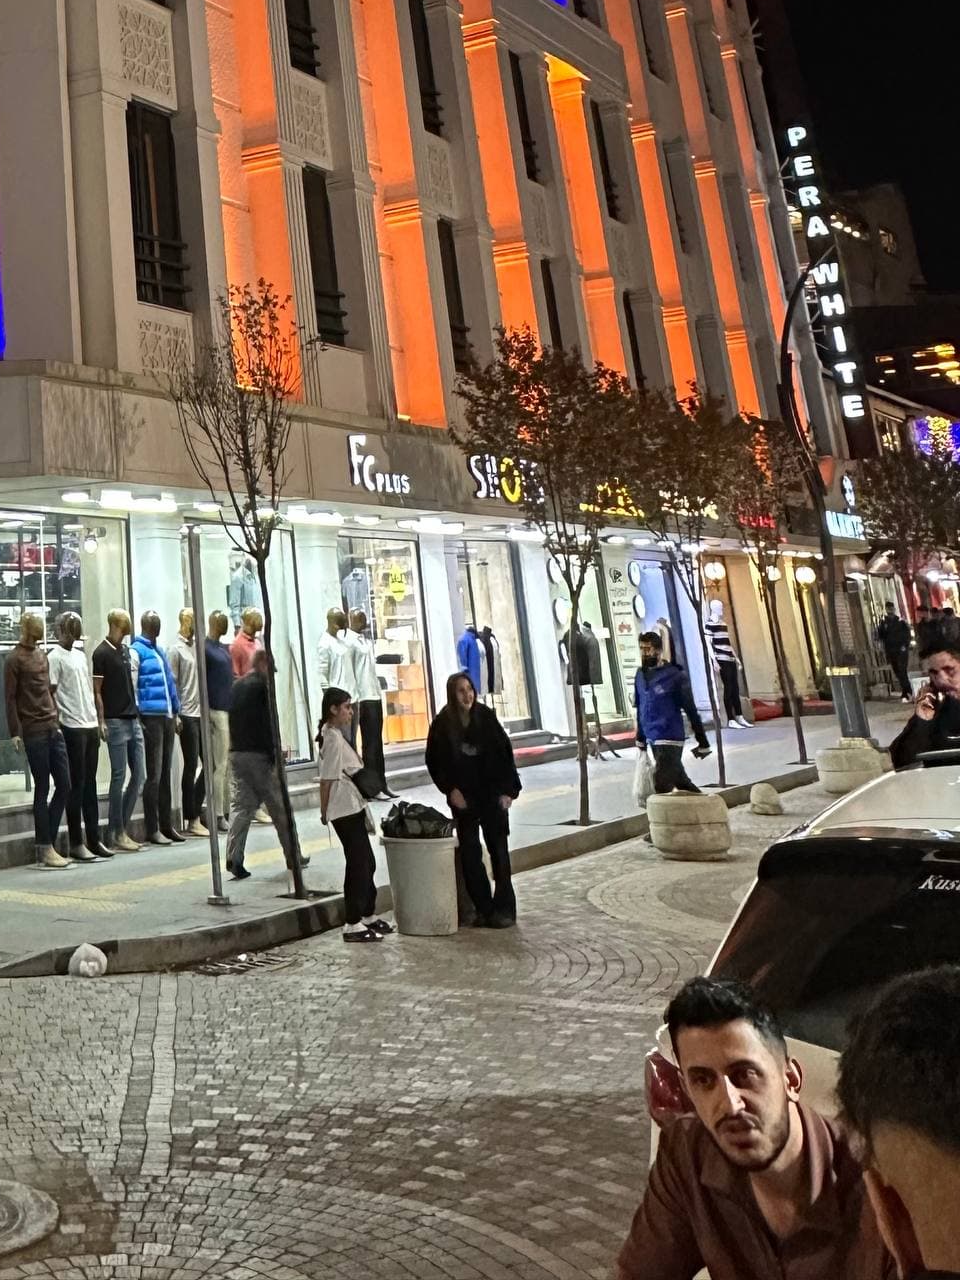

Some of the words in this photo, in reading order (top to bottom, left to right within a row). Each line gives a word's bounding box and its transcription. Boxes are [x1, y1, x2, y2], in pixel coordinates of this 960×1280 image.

[787, 126, 829, 238] PERA
[810, 262, 864, 418] WHITE
[349, 434, 375, 491] FC
[376, 473, 410, 494] PLUS
